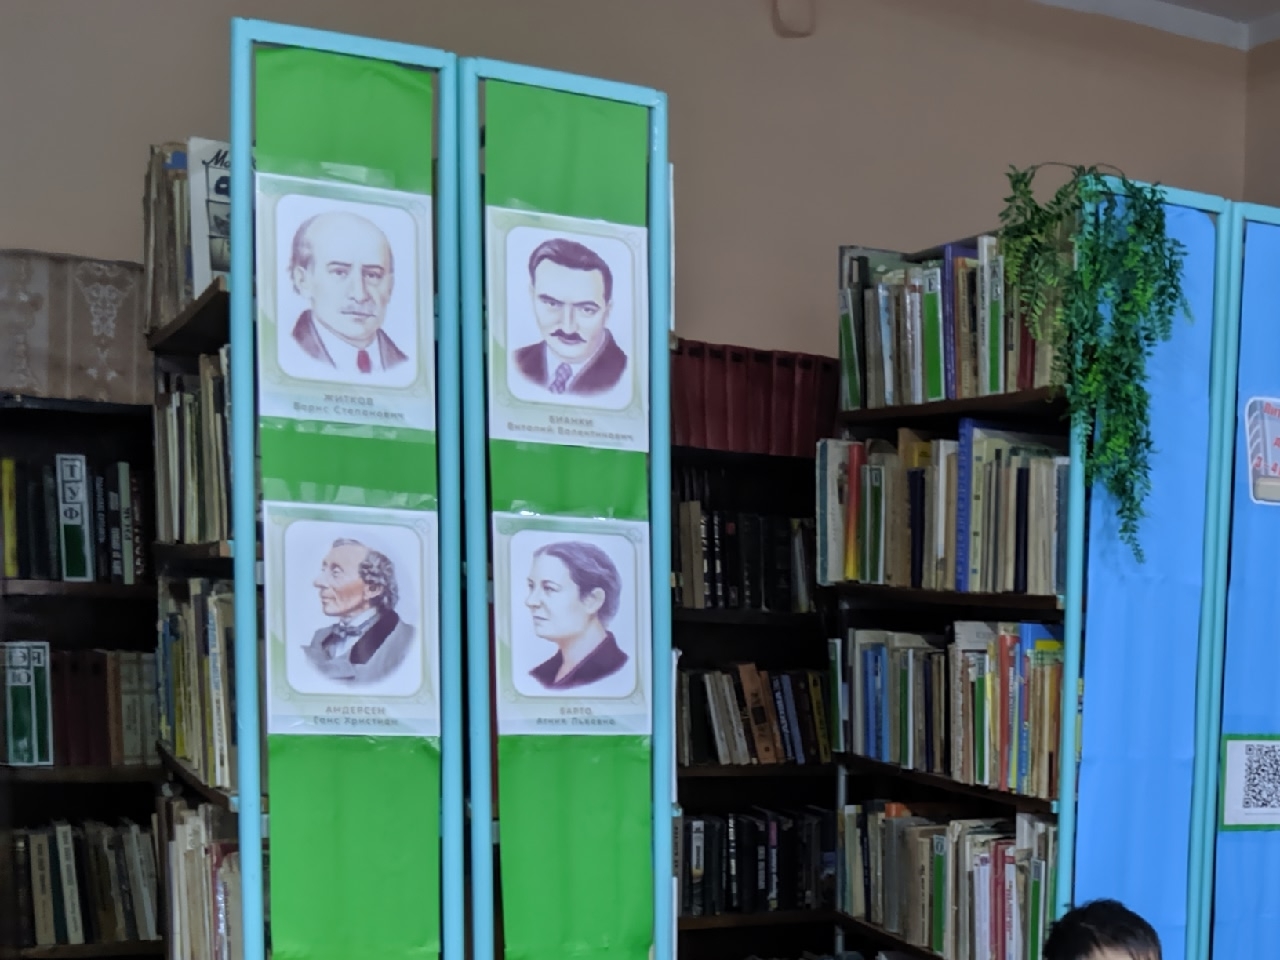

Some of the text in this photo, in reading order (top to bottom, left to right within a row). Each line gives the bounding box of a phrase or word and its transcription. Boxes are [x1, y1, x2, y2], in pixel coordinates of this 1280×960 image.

[323, 394, 374, 406] ЖИТКОВ
[293, 401, 405, 420] Борис Степанович
[549, 415, 594, 427] БИАНКИ
[507, 422, 634, 442] Виталий Валентинович
[65, 463, 78, 478] Т
[66, 486, 80, 501] У
[63, 507, 79, 520] Ф
[325, 706, 386, 715] АНДЕРСЕН
[559, 706, 593, 716] БАРТО
[313, 715, 399, 728] Ганс Христиан
[536, 717, 617, 726] Агния Львовна
